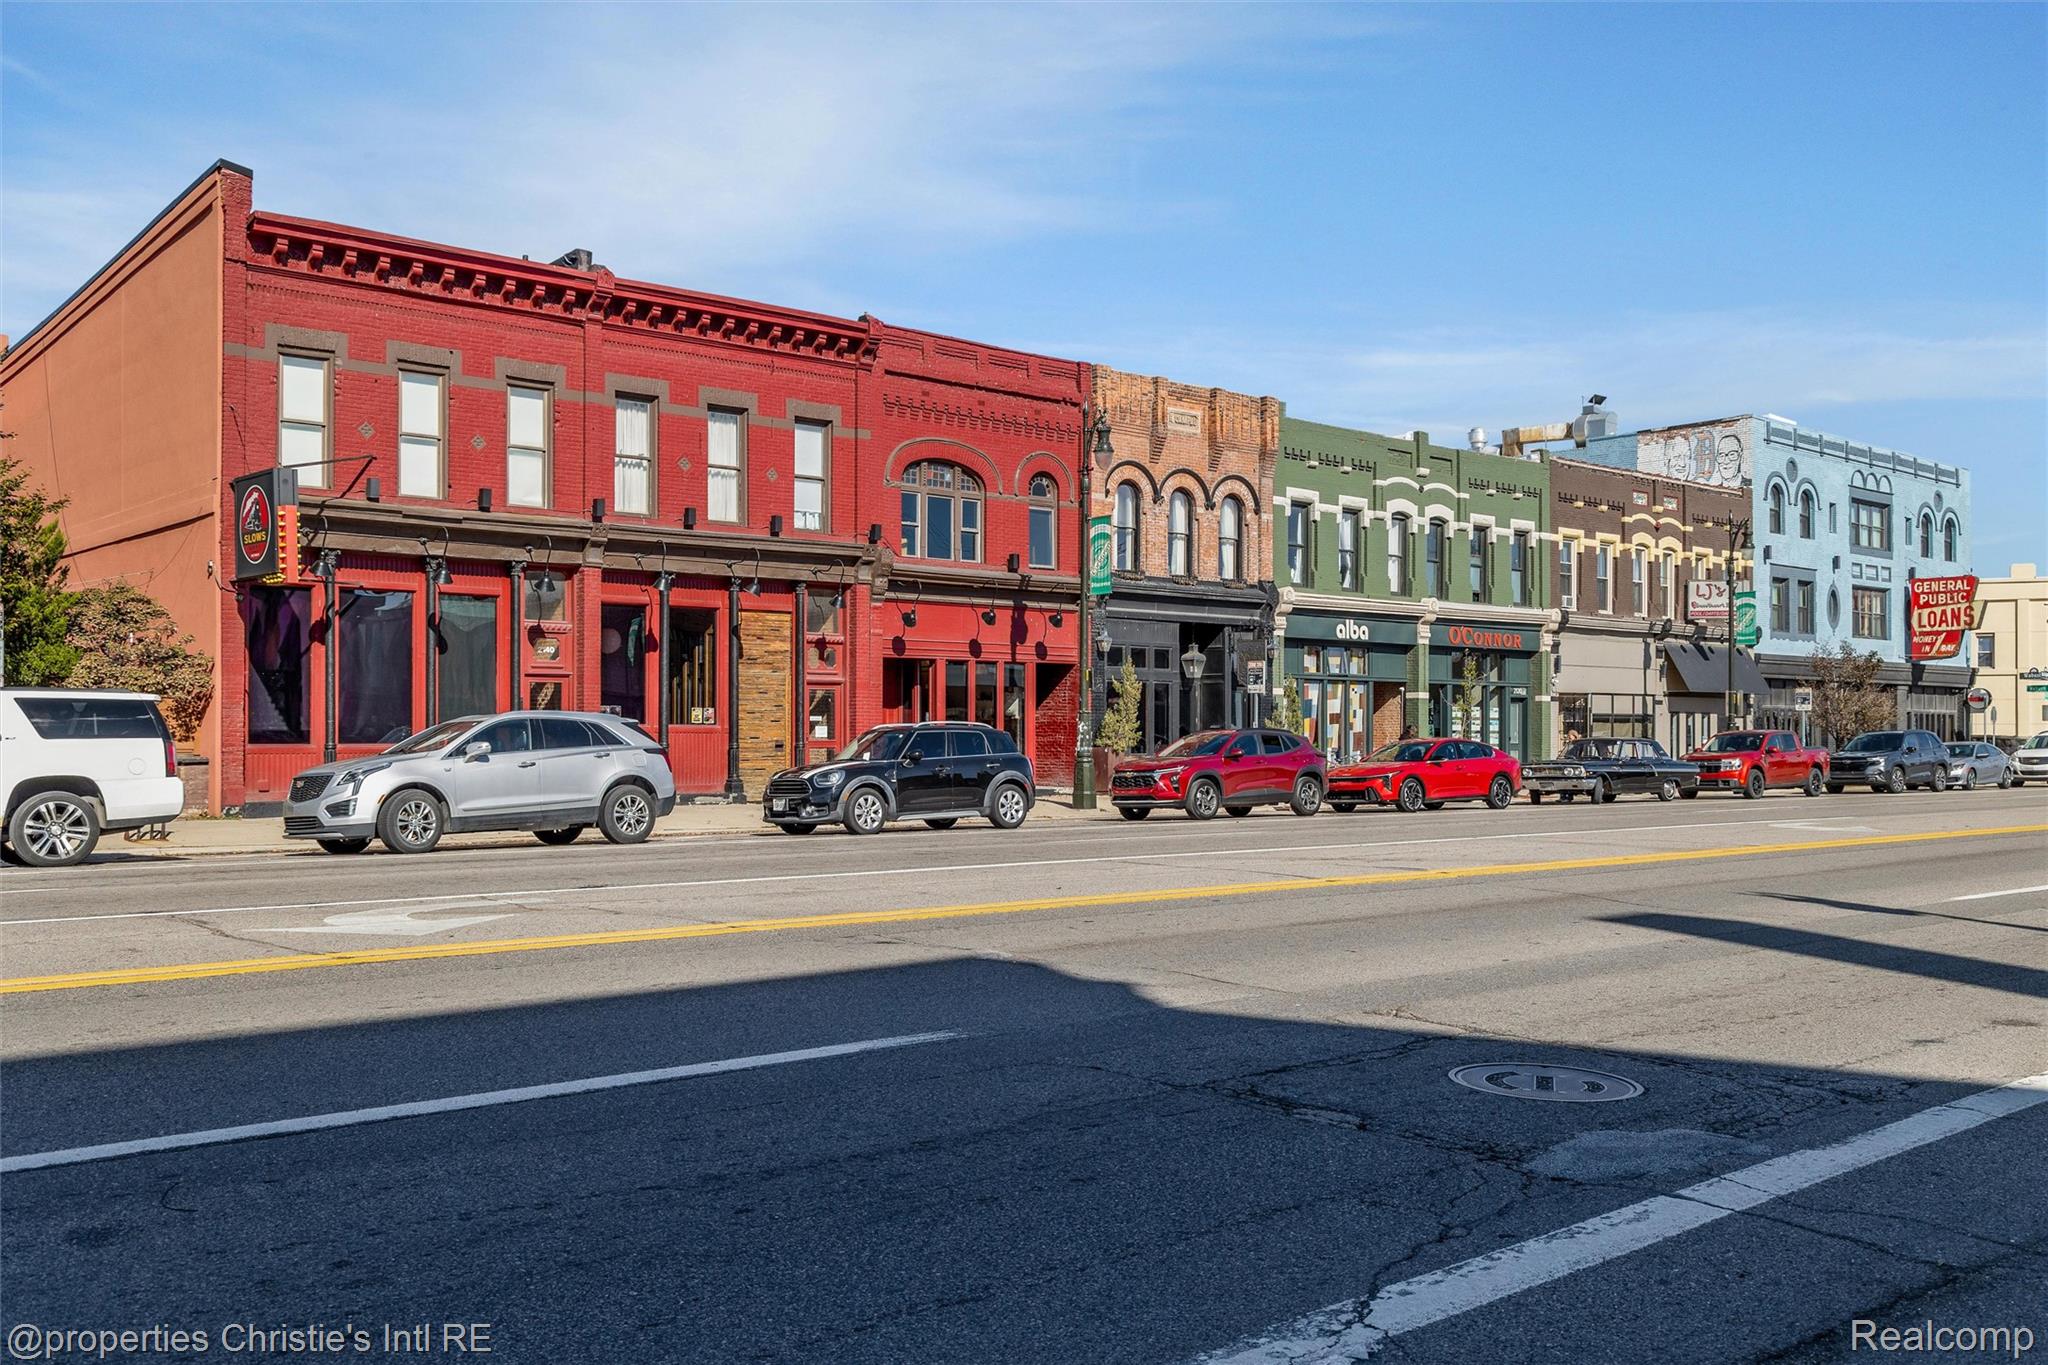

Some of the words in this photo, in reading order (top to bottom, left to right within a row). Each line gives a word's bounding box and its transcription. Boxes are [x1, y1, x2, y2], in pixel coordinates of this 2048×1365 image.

[244, 531, 267, 544] SLOWS
[1914, 580, 1971, 593] GENERAL
[1919, 592, 1967, 605] PUBLIC
[1917, 606, 1975, 629] LOANS
[1336, 619, 1369, 640] alba
[1912, 635, 1936, 643] MONEY
